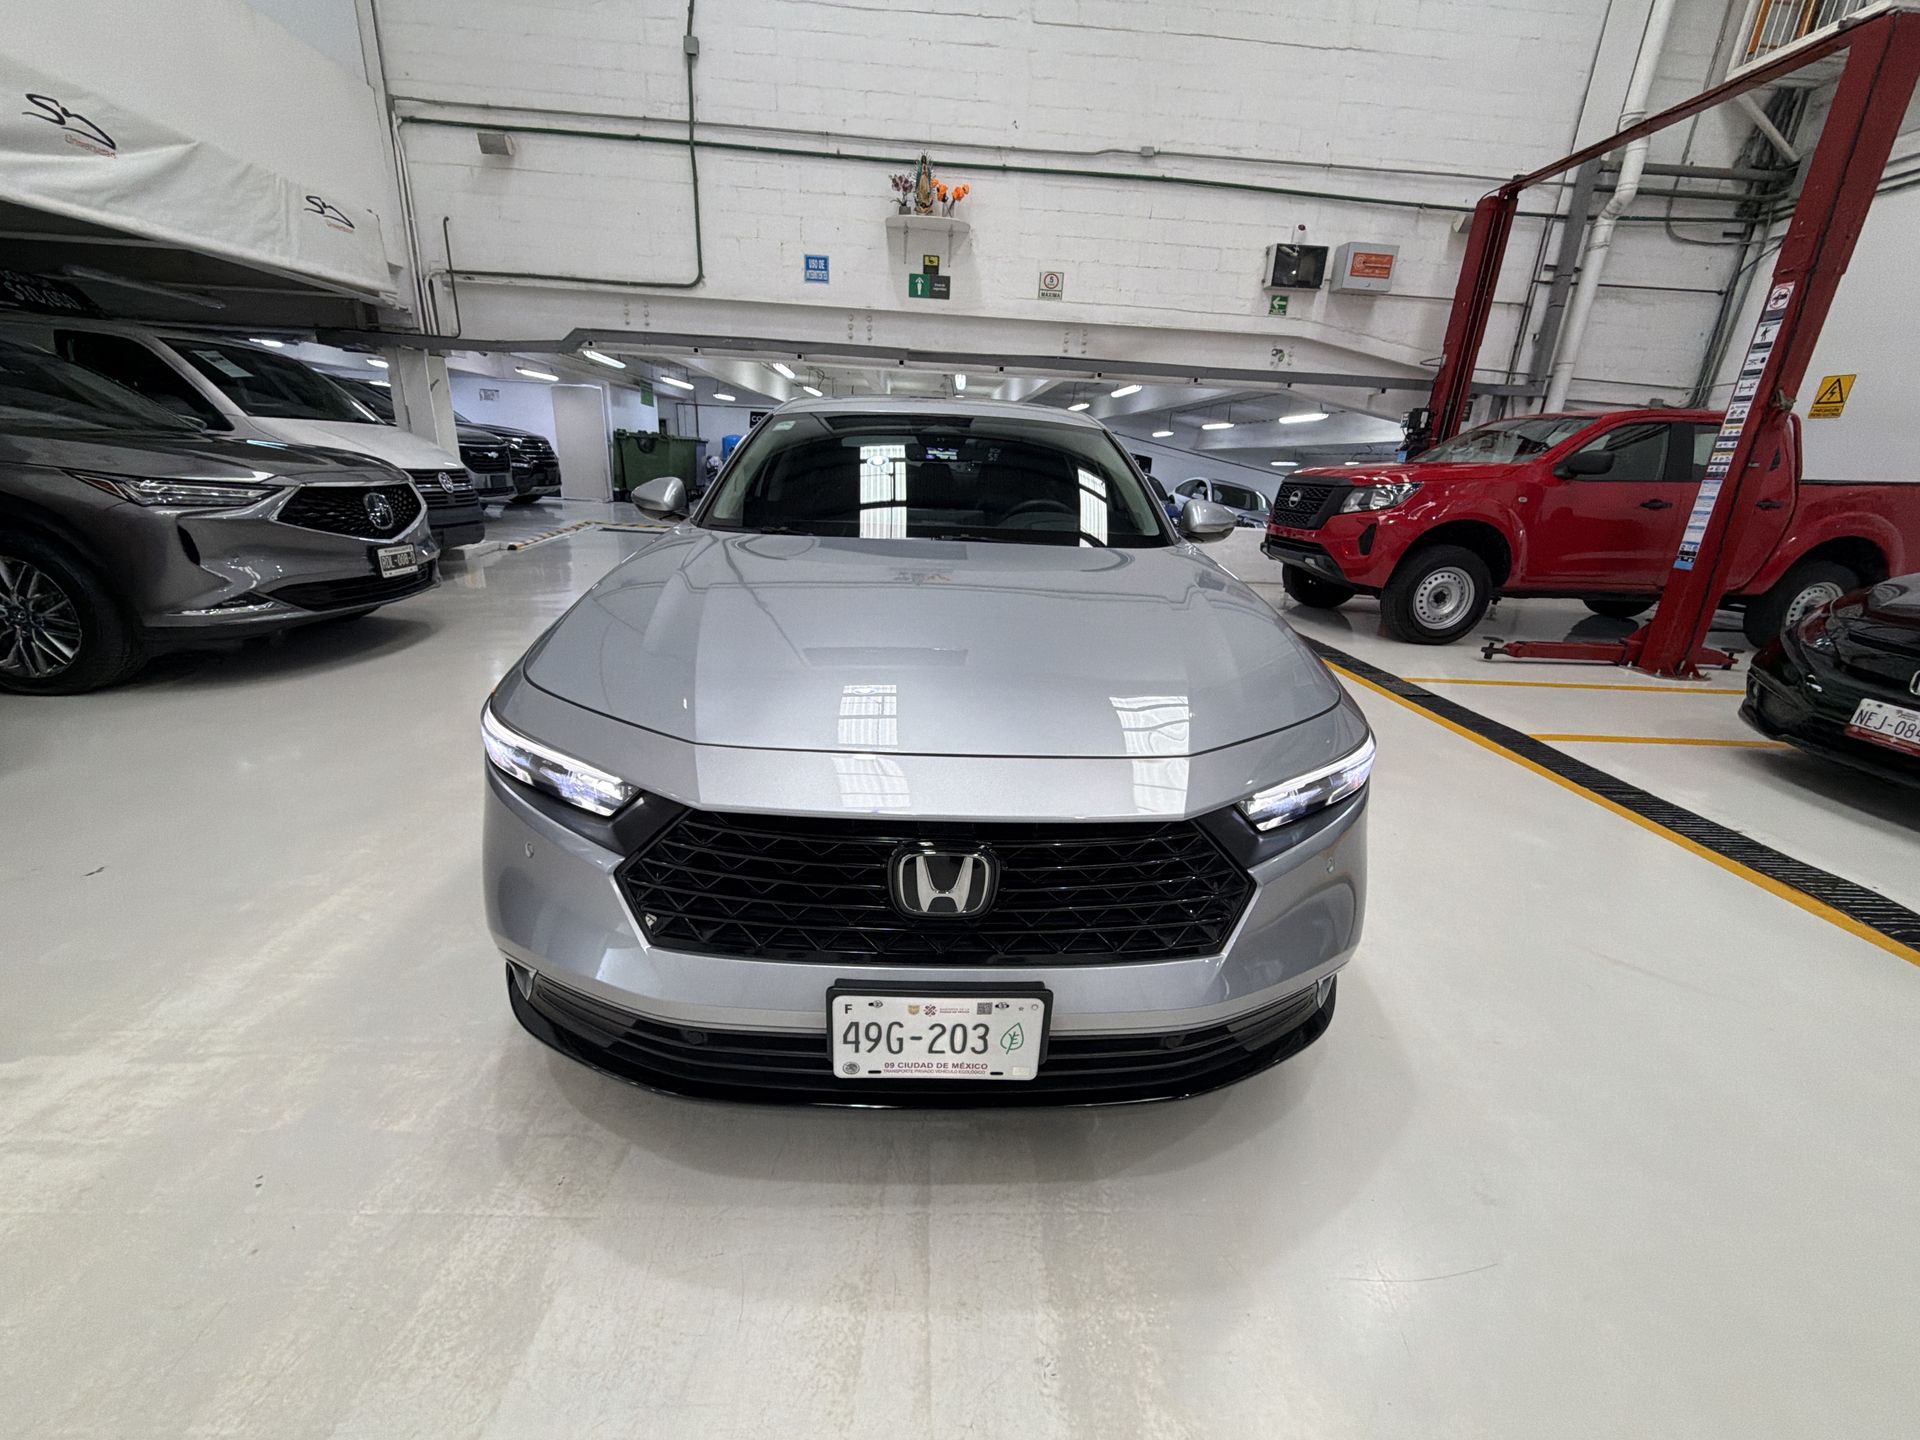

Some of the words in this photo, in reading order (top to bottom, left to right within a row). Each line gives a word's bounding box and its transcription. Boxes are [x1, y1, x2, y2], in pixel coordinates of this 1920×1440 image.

[845, 1004, 853, 1014] F
[842, 1021, 990, 1055] 49G-203
[951, 1062, 988, 1070] MÉXICO
